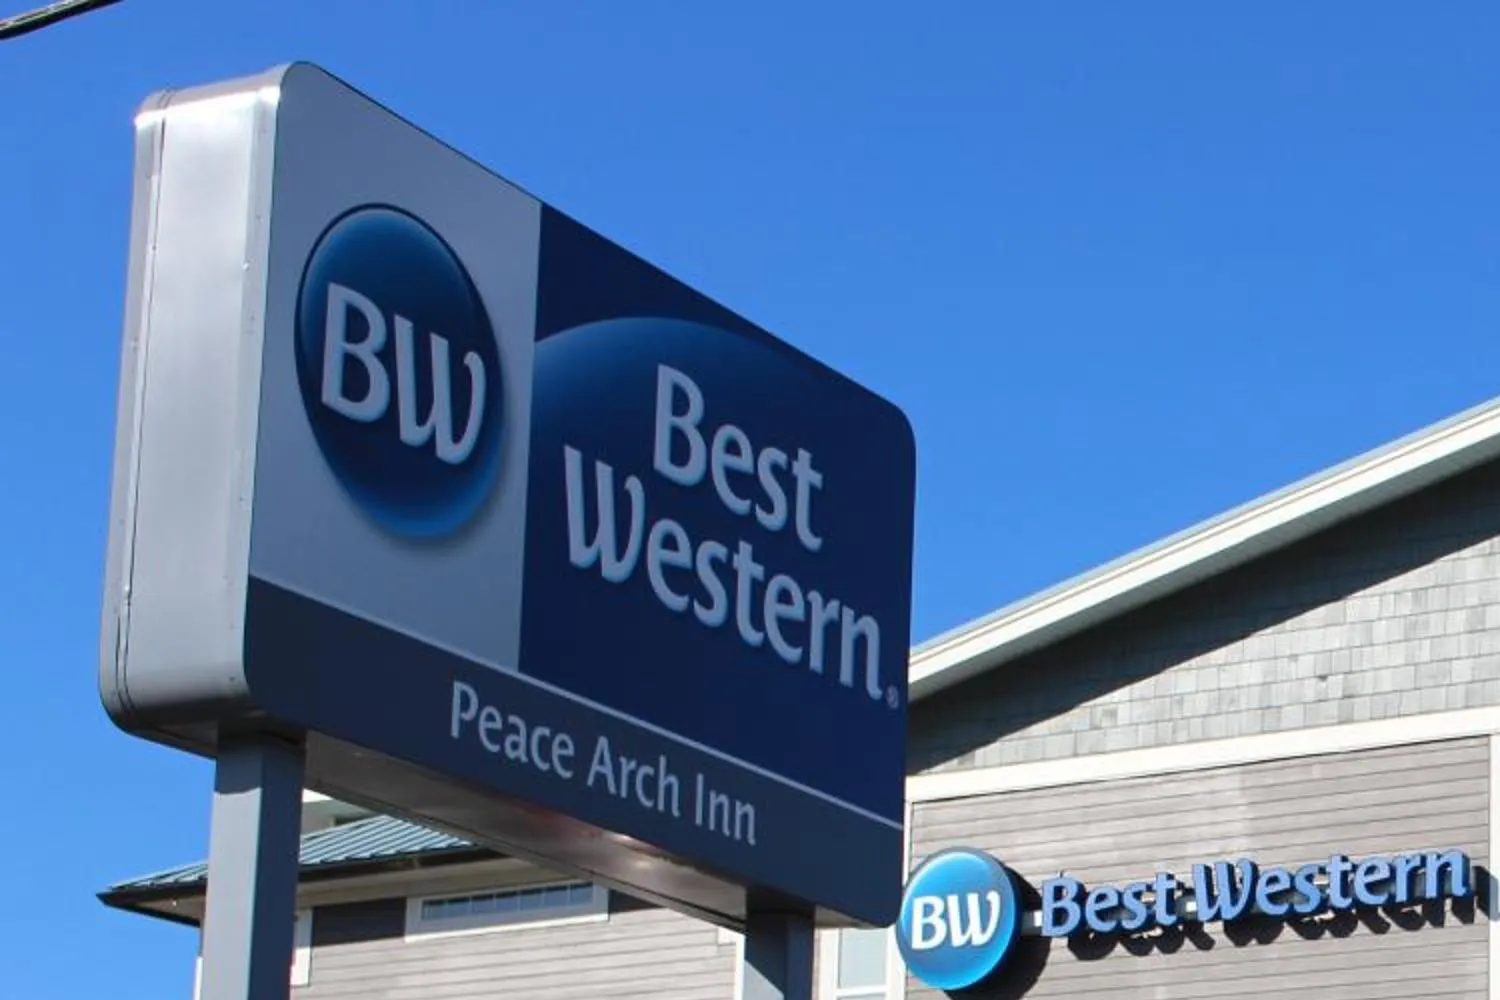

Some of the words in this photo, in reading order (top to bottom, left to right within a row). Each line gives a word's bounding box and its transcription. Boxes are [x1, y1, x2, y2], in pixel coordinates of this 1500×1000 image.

[321, 281, 486, 465] BW
[653, 362, 823, 551] Best
[563, 444, 884, 700] Western
[450, 679, 575, 780] Peace
[587, 733, 681, 818] Arch
[694, 772, 757, 846] Inn
[910, 890, 1001, 951] BW
[1040, 873, 1184, 938] Best
[1192, 848, 1472, 922] Western
